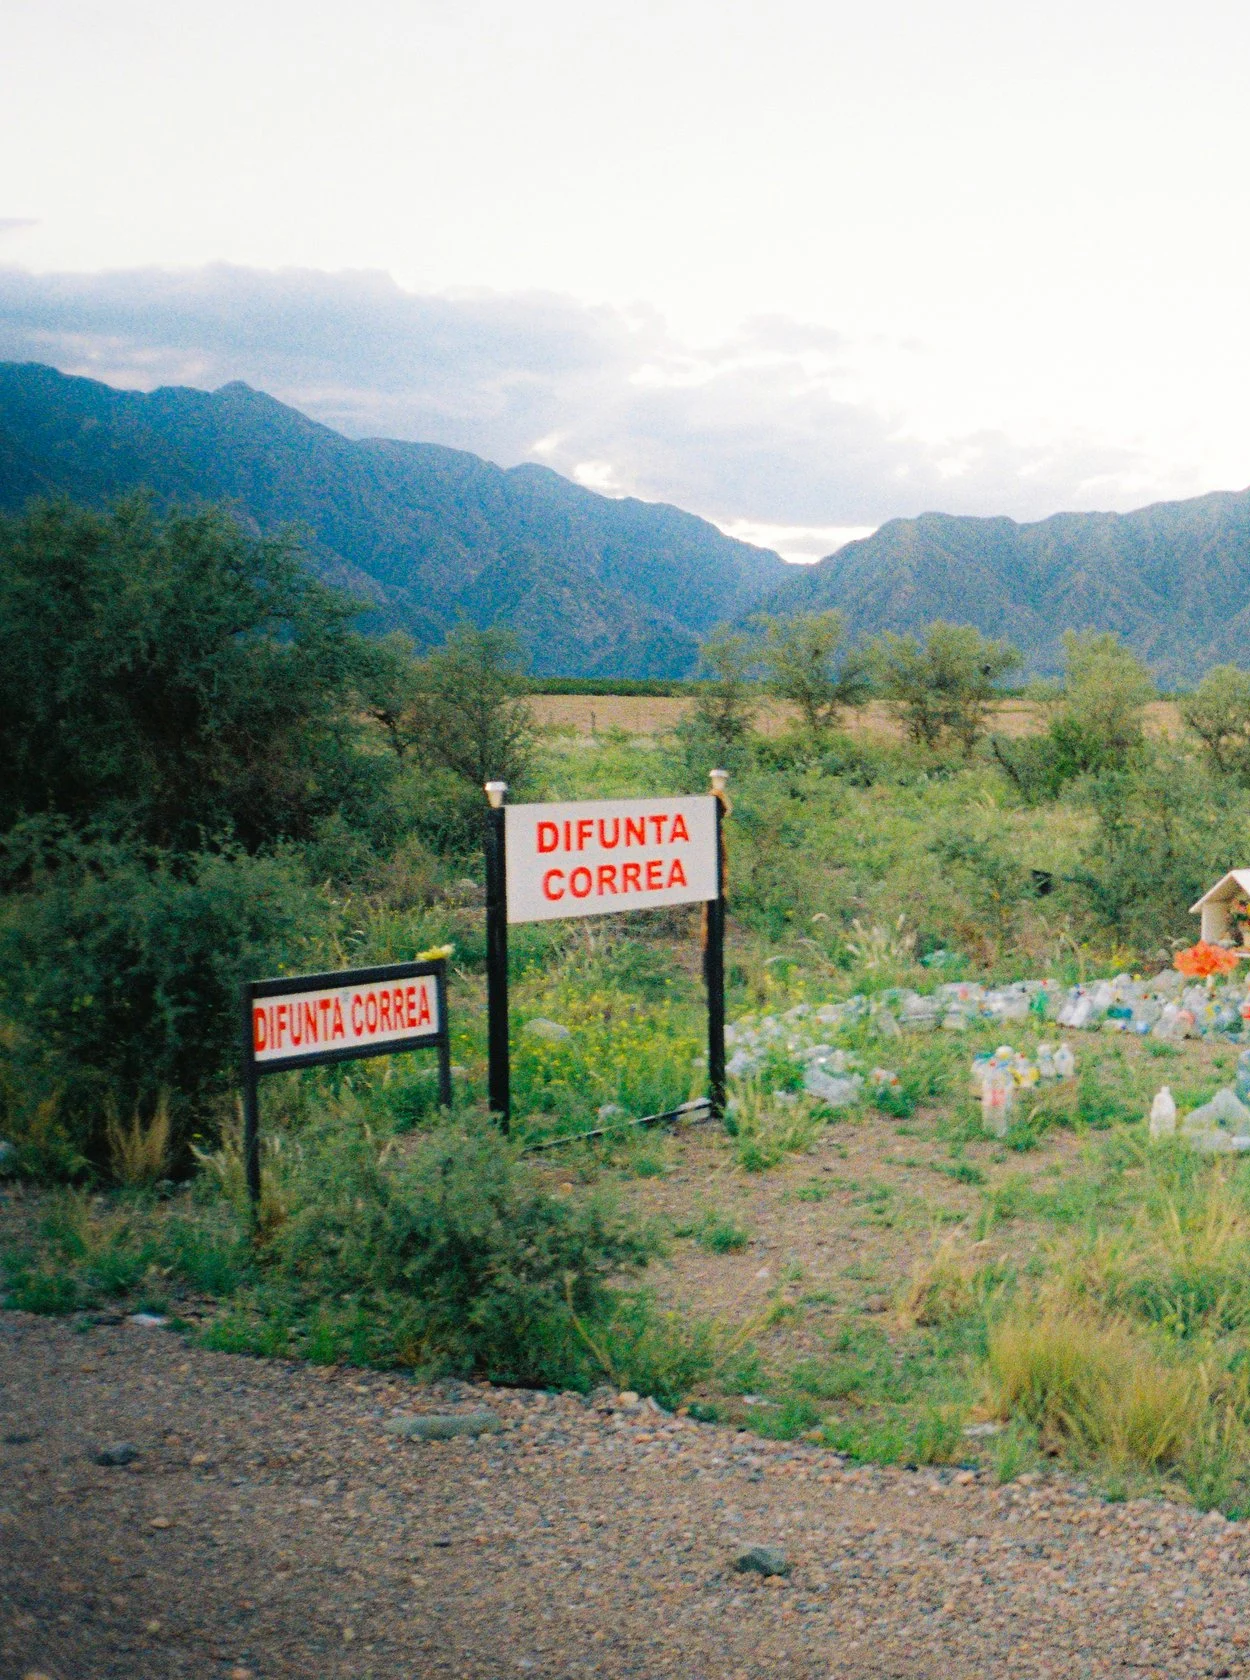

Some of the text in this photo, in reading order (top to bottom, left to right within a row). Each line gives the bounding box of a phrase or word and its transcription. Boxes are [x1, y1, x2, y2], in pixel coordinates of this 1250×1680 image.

[536, 812, 690, 854] DIFUNTA
[541, 858, 688, 902] CORREA
[253, 984, 431, 1053] DIFUNTA CORREA
